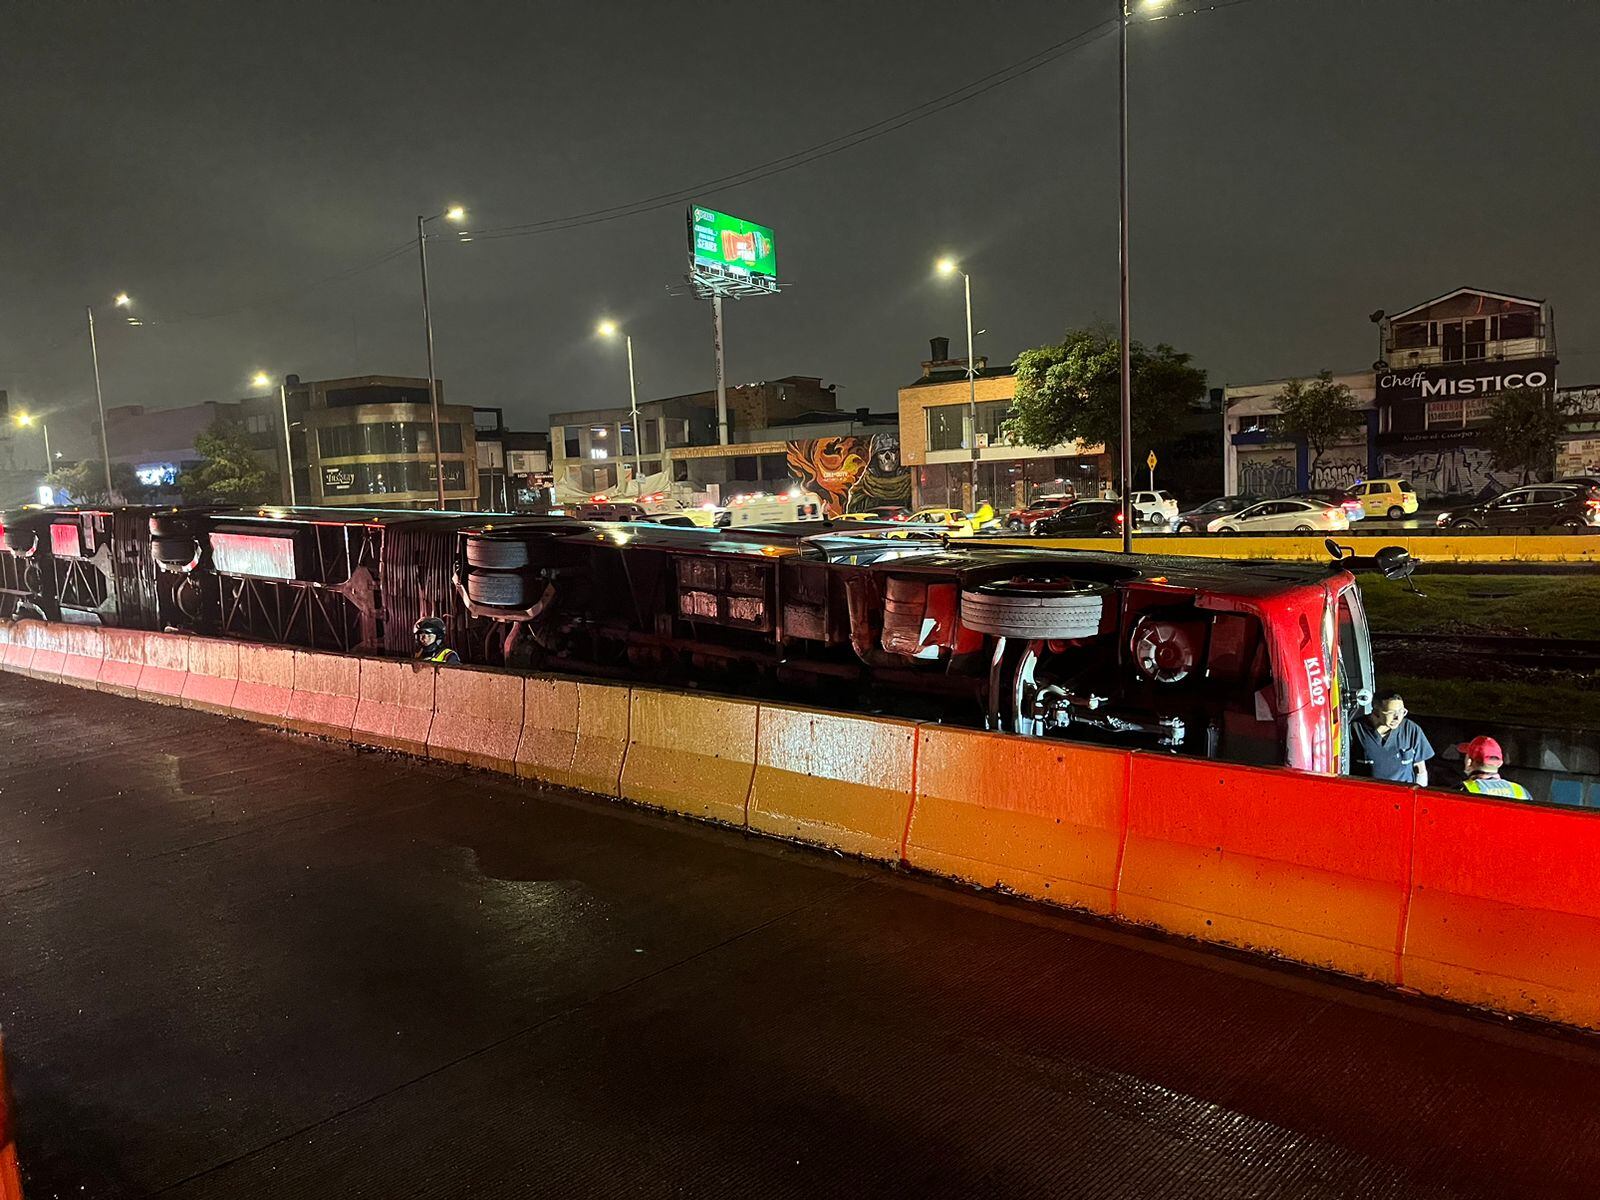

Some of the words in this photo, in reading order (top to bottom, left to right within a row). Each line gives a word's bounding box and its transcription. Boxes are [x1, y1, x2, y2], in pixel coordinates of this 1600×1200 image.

[1381, 371, 1426, 388] Cheff
[1421, 372, 1547, 397] MISTICO
[1441, 431, 1473, 440] Cuerpo
[1306, 657, 1326, 706] K1409
